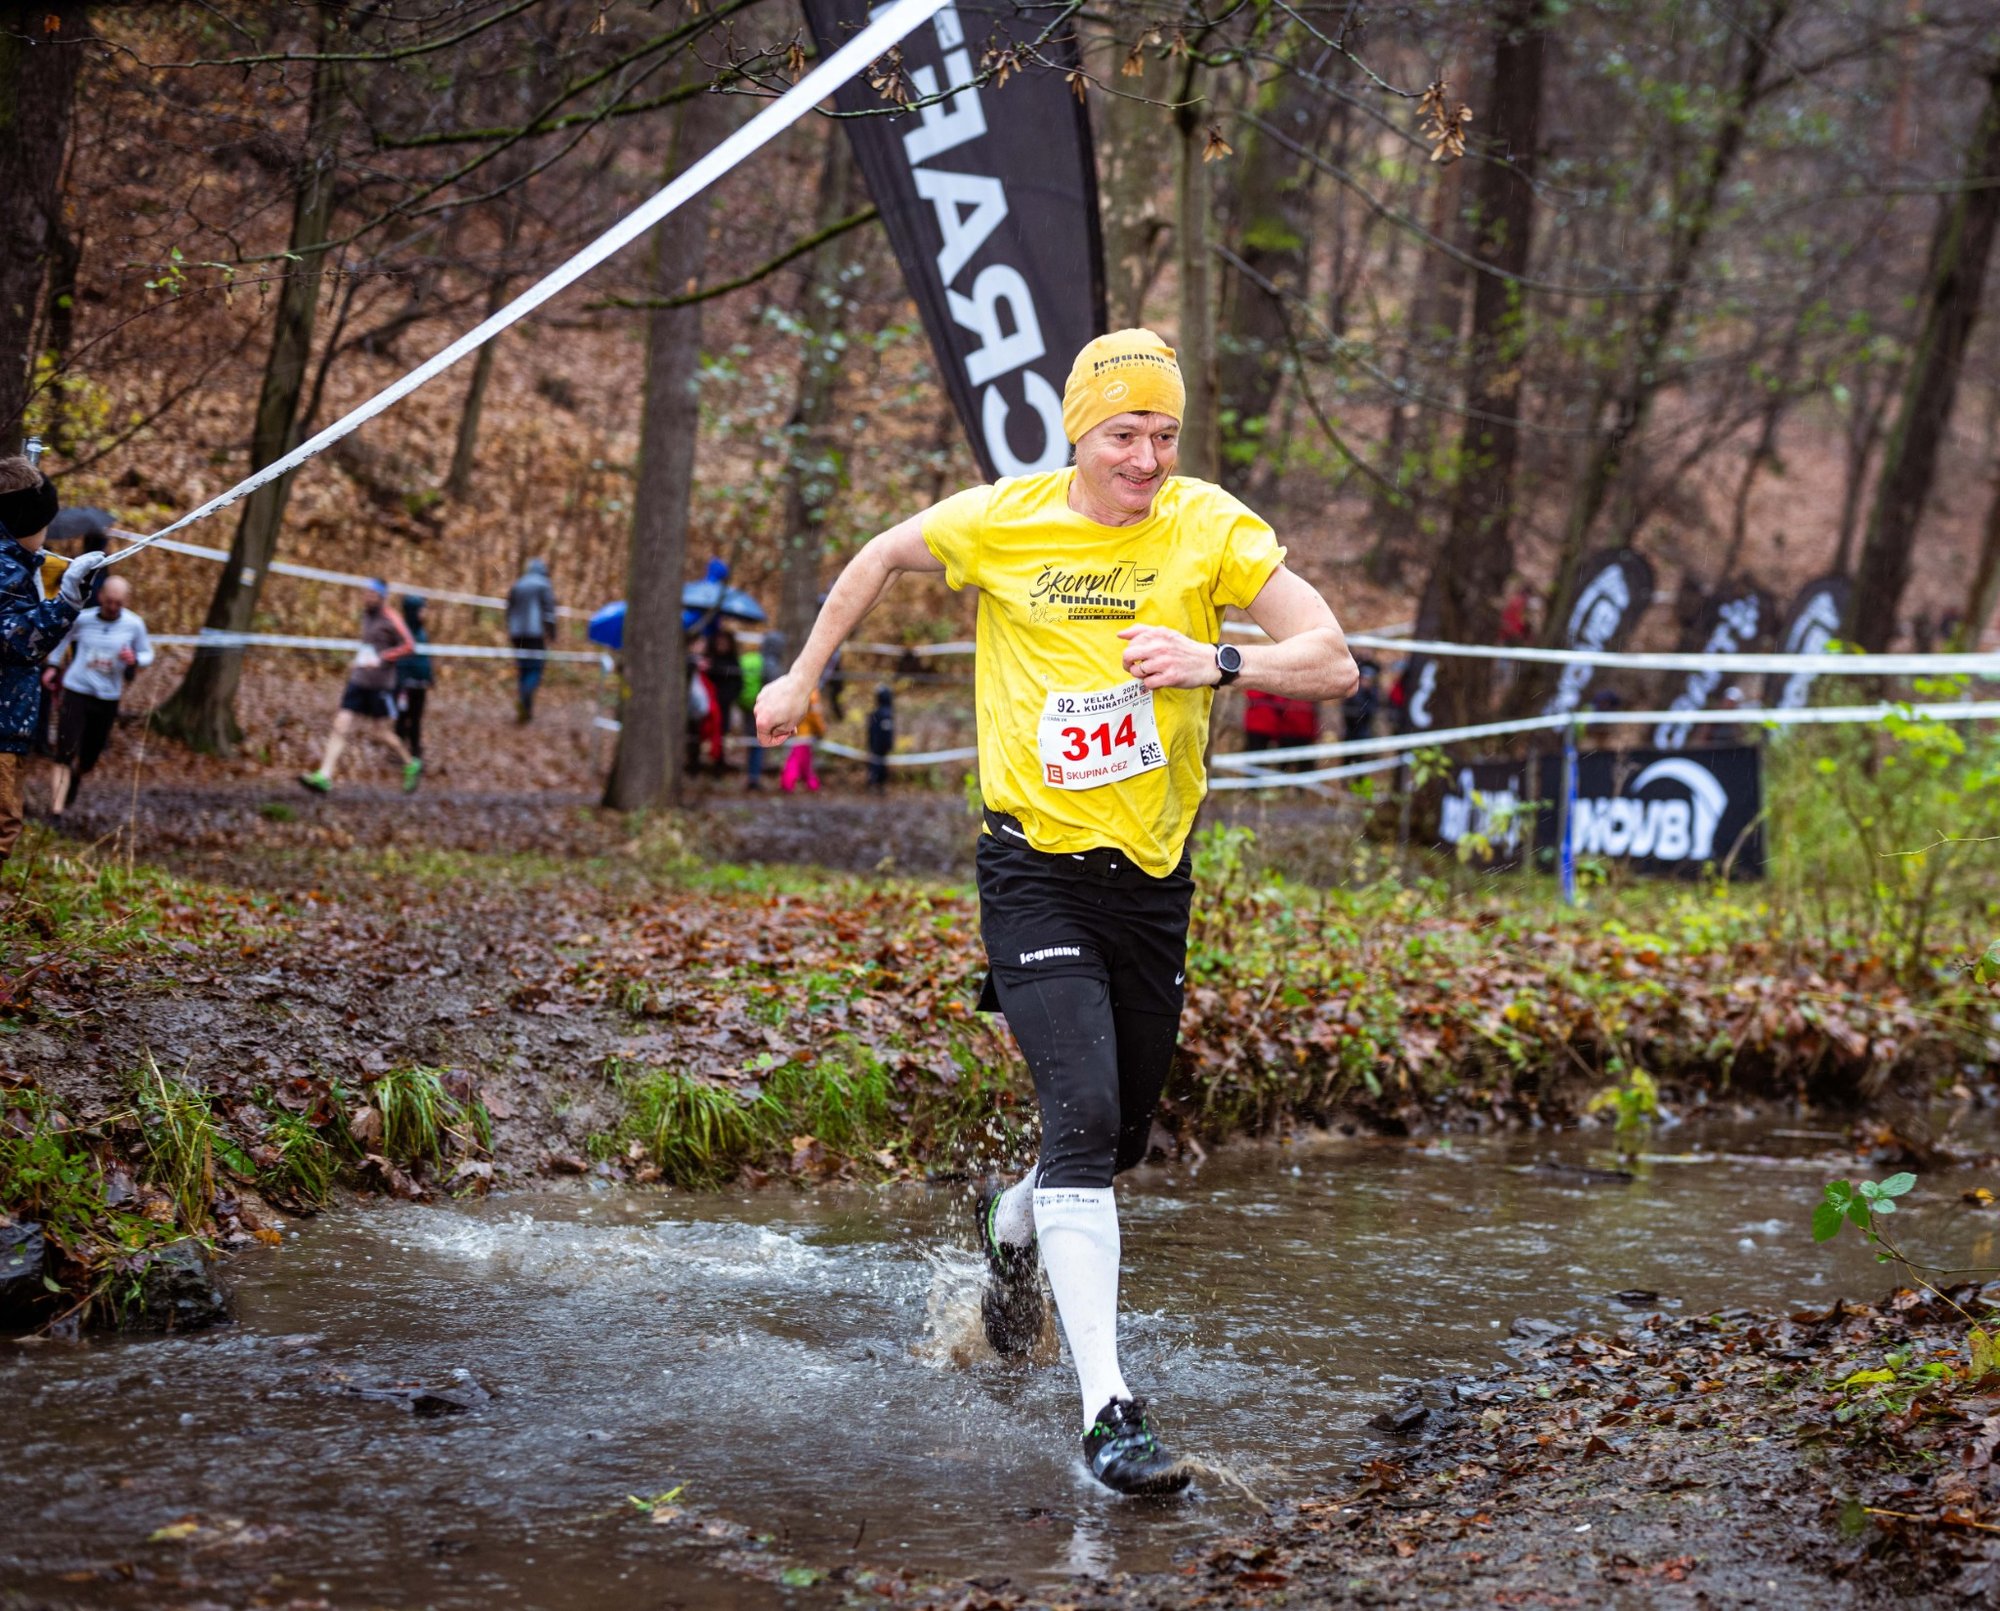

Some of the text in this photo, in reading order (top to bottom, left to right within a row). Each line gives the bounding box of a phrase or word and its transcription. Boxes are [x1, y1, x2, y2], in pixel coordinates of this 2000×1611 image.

[1057, 698, 1081, 714] 92.
[1061, 713, 1137, 762] 314
[1066, 760, 1128, 781] SKUPINA ČEZ
